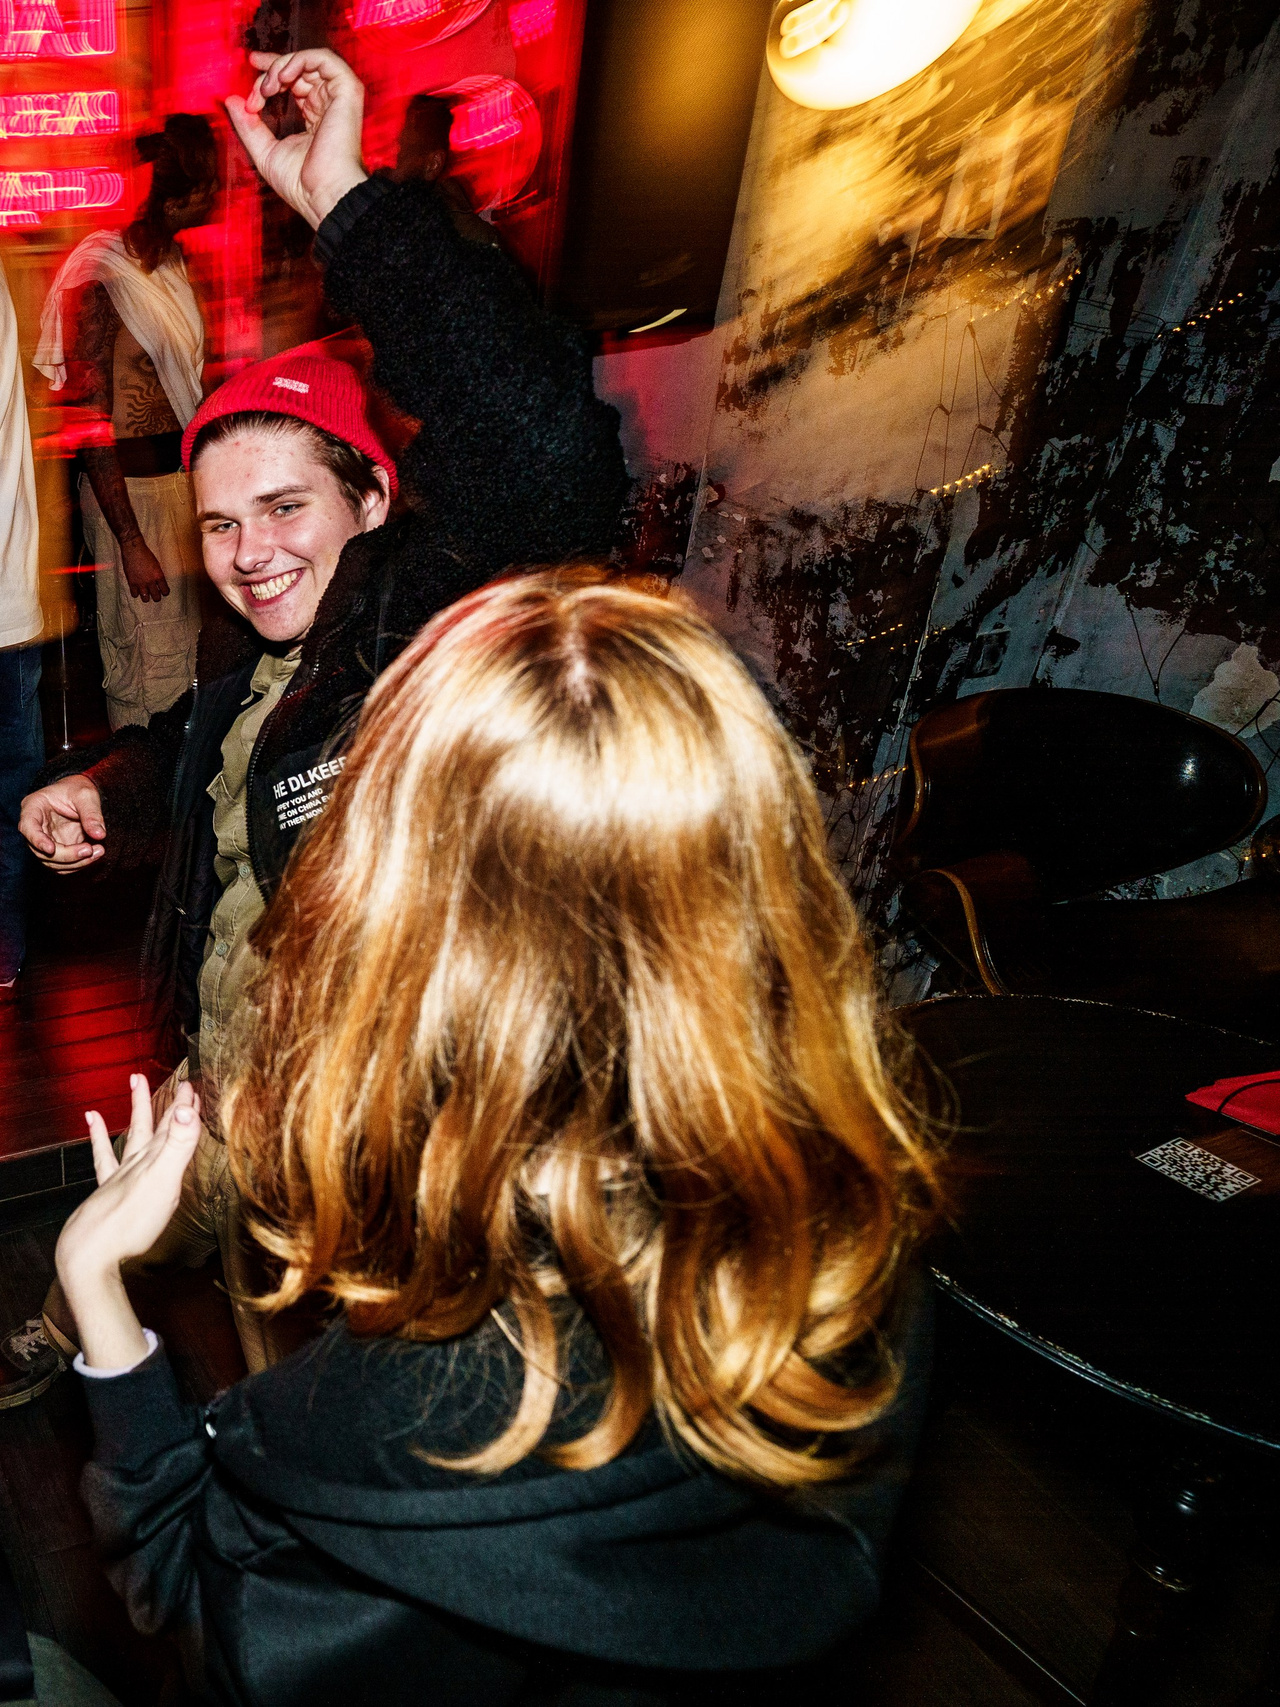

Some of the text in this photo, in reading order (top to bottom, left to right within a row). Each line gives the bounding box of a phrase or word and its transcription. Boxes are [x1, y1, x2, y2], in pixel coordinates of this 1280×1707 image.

[290, 795, 307, 806] YOU
[307, 788, 323, 799] AND
[287, 809, 298, 818] ON
[298, 799, 322, 813] CHINA
